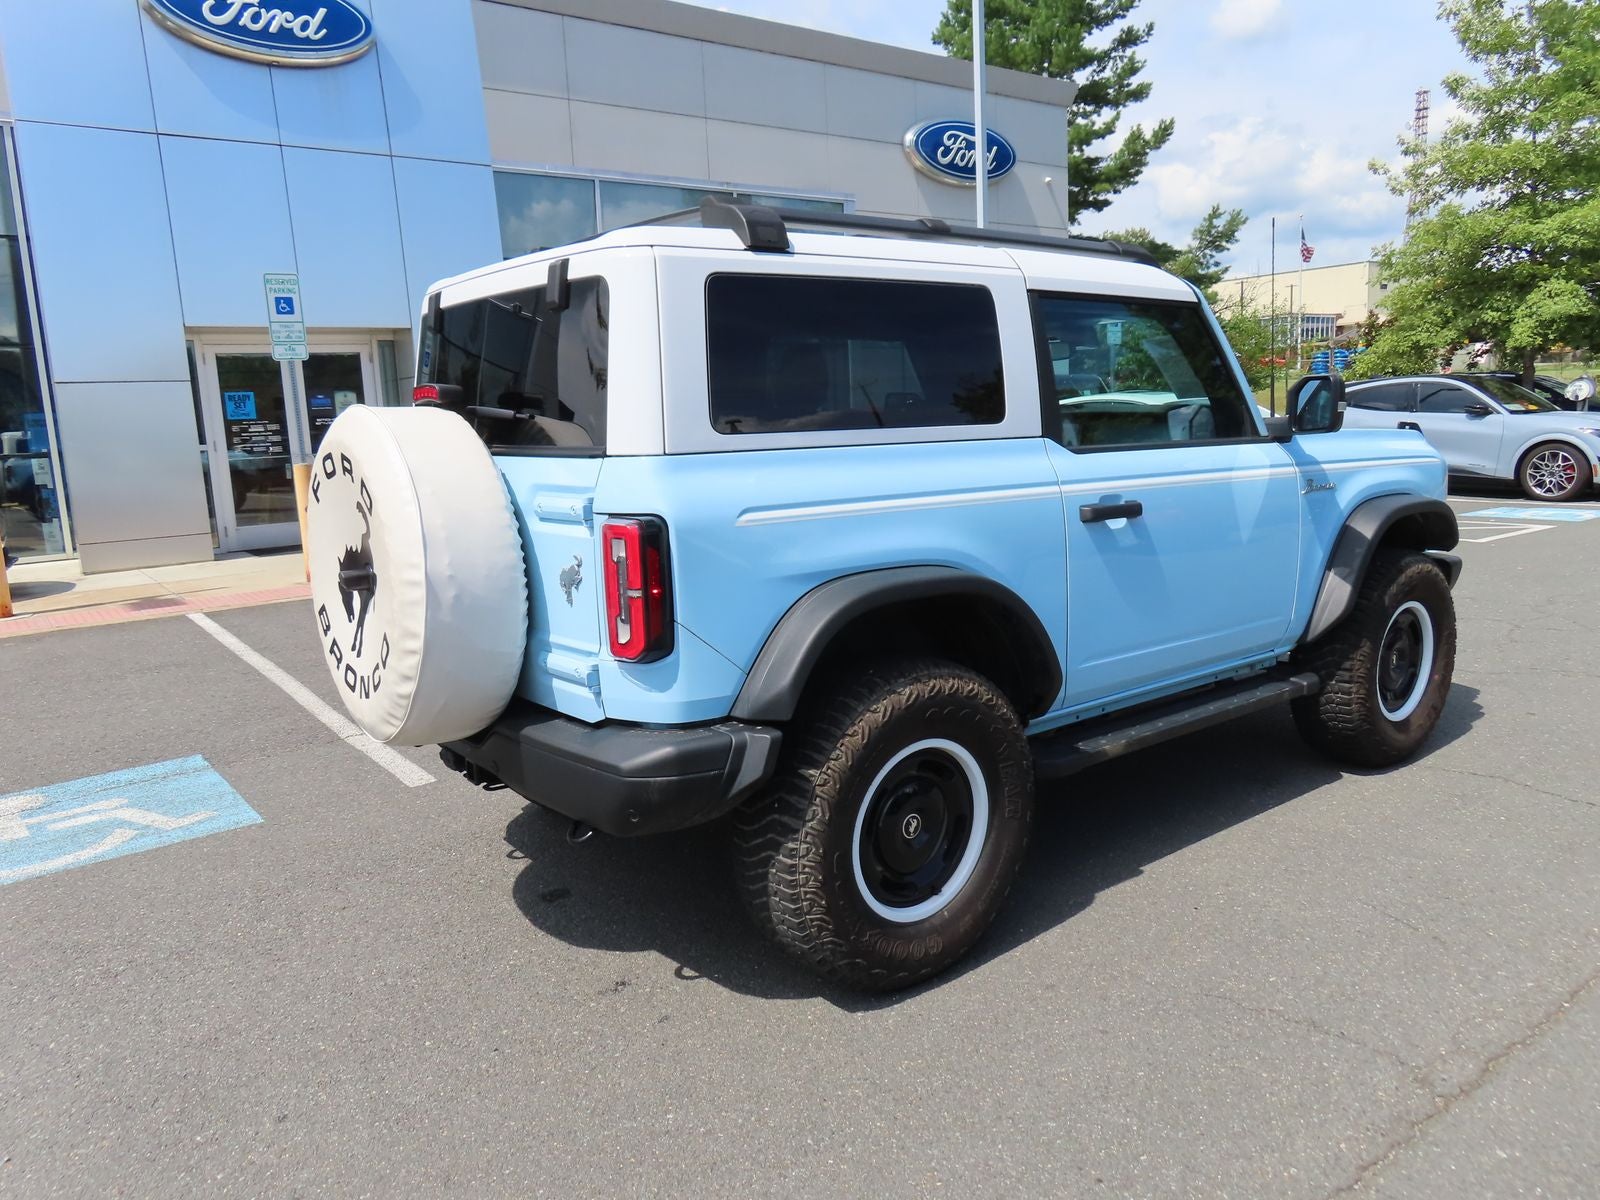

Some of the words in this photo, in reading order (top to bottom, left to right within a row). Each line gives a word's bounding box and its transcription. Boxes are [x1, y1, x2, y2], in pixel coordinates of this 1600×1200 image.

[227, 394, 251, 402] READY
[311, 452, 373, 517] FORD
[318, 603, 390, 700] BRONCO
